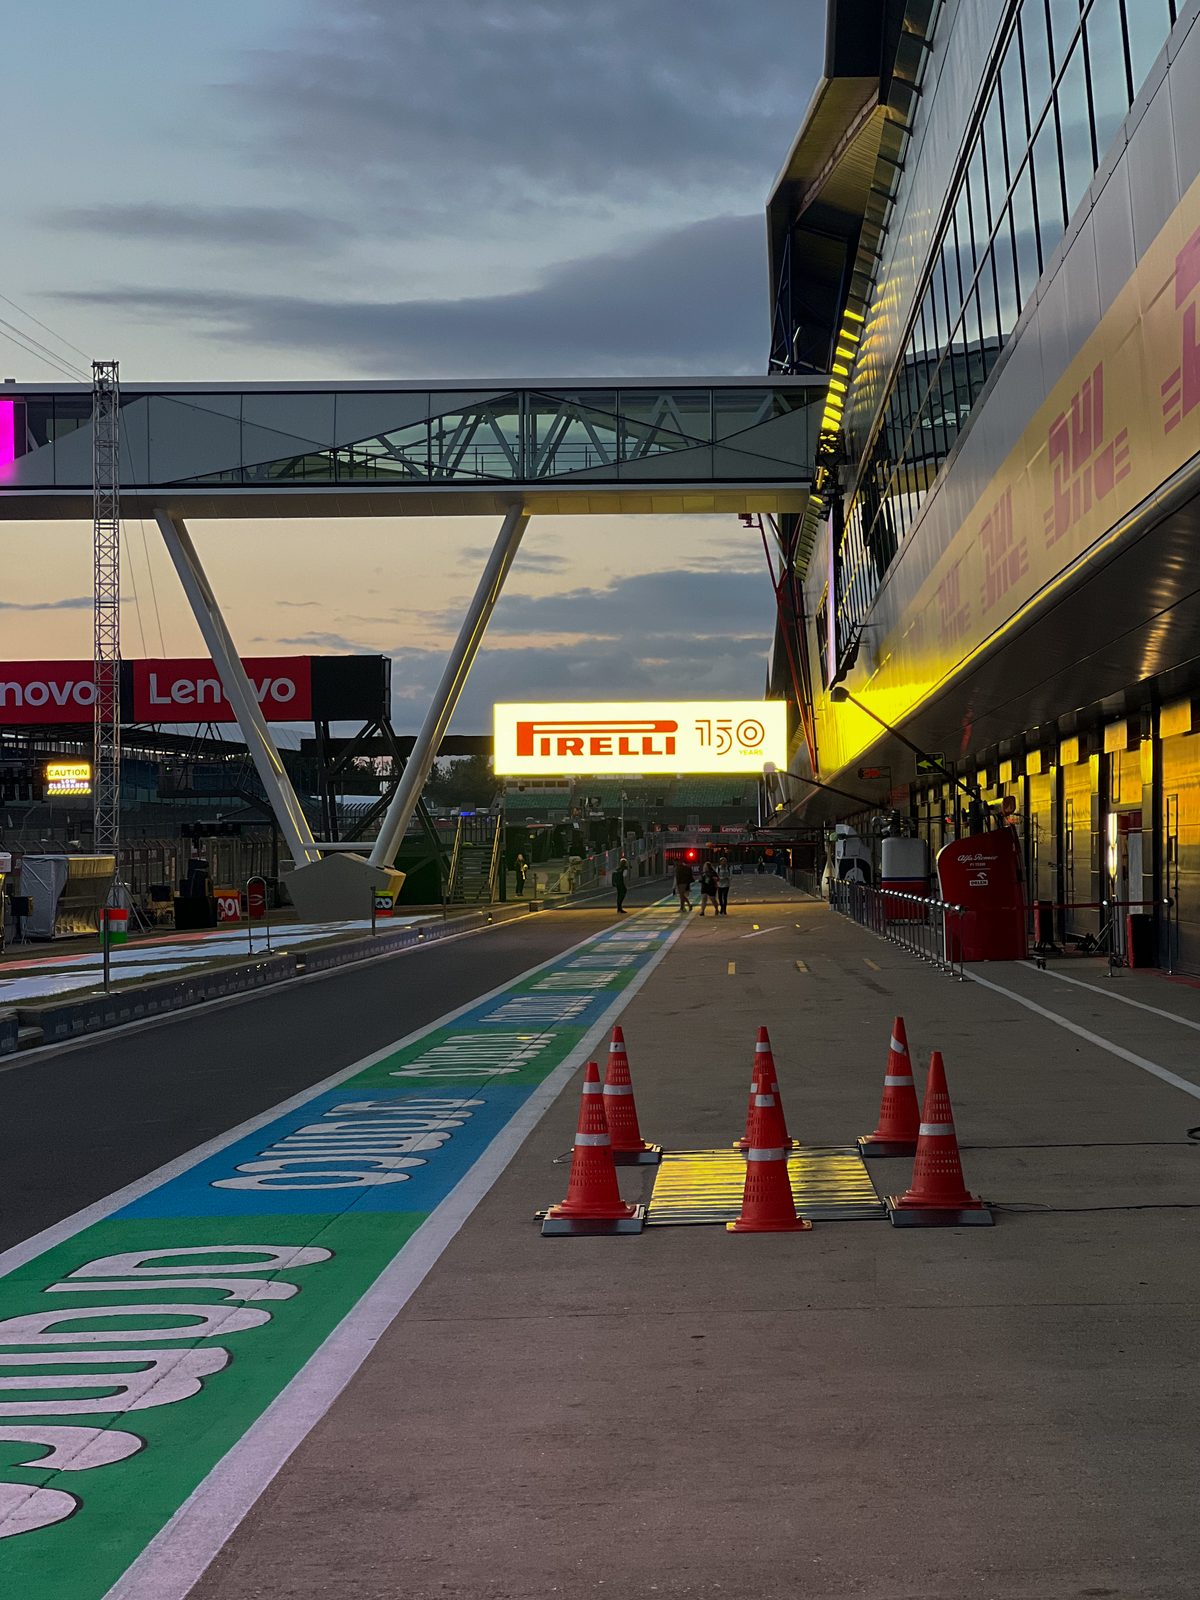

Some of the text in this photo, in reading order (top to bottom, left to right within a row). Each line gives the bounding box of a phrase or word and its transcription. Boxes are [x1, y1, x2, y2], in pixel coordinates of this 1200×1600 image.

[149, 672, 296, 705] Lenvo
[516, 719, 765, 757] PIRELLI 150
[738, 748, 764, 756] YEARS
[957, 855, 973, 863] Alfa
[211, 1097, 486, 1191] aramco
[0, 1244, 335, 1539] aram
